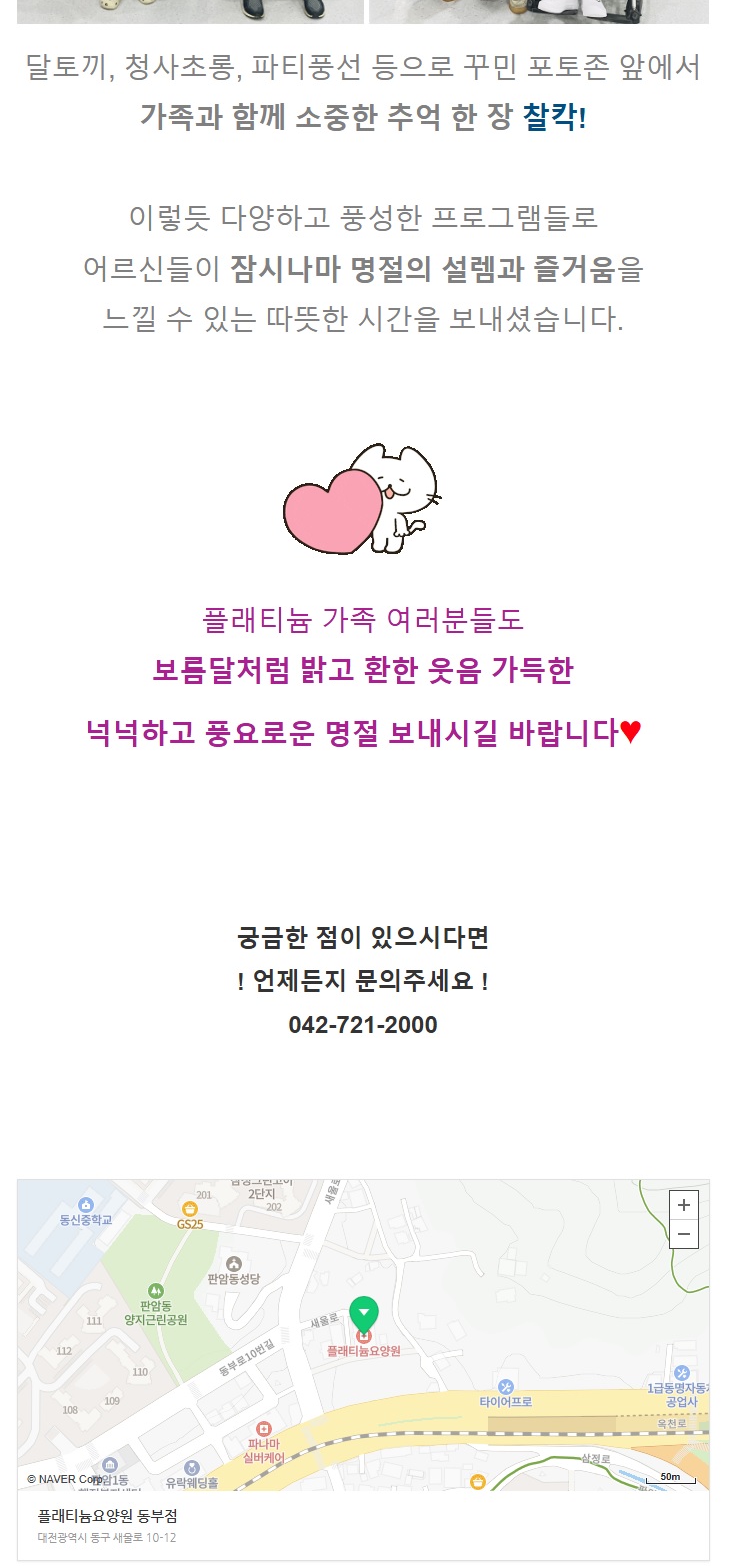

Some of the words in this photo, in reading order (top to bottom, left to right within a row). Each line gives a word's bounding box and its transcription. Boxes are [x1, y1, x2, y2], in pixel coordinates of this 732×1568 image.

[196, 1191, 211, 1199] 201
[248, 1188, 275, 1199] 2단지
[266, 1203, 282, 1211] 202
[60, 1215, 112, 1226] 동신중학교
[177, 1220, 204, 1230] GS25
[207, 1274, 260, 1285] 판암동성당
[140, 1301, 172, 1312] 판암동
[86, 1317, 102, 1326] 111
[124, 1314, 188, 1326] 양지근린공원
[310, 1312, 339, 1329] 새울로
[56, 1347, 72, 1355] 112
[327, 1345, 401, 1357] 플래티늄요양원
[219, 1339, 274, 1377] 동부로10번길
[132, 1368, 148, 1376] 110
[104, 1397, 120, 1406] 109
[480, 1397, 532, 1408] 타이어프로
[666, 1396, 698, 1408] 공업사
[62, 1406, 78, 1414] 108
[657, 1419, 687, 1429] 옥천로
[248, 1438, 280, 1450] 파나마
[243, 1452, 285, 1464] 실버케어
[582, 1453, 611, 1464] 삼정로
[39, 1475, 76, 1483] NAVER
[660, 1473, 681, 1481] 50m
[166, 1478, 218, 1489] 유락웨딩홀
[38, 1509, 133, 1524] 플래티늄요양원
[137, 1509, 177, 1524] 동부점
[38, 1533, 87, 1544] 대전광역시
[90, 1533, 111, 1544] 동구
[113, 1533, 143, 1544] 새울로
[147, 1533, 177, 1544] 10-12
